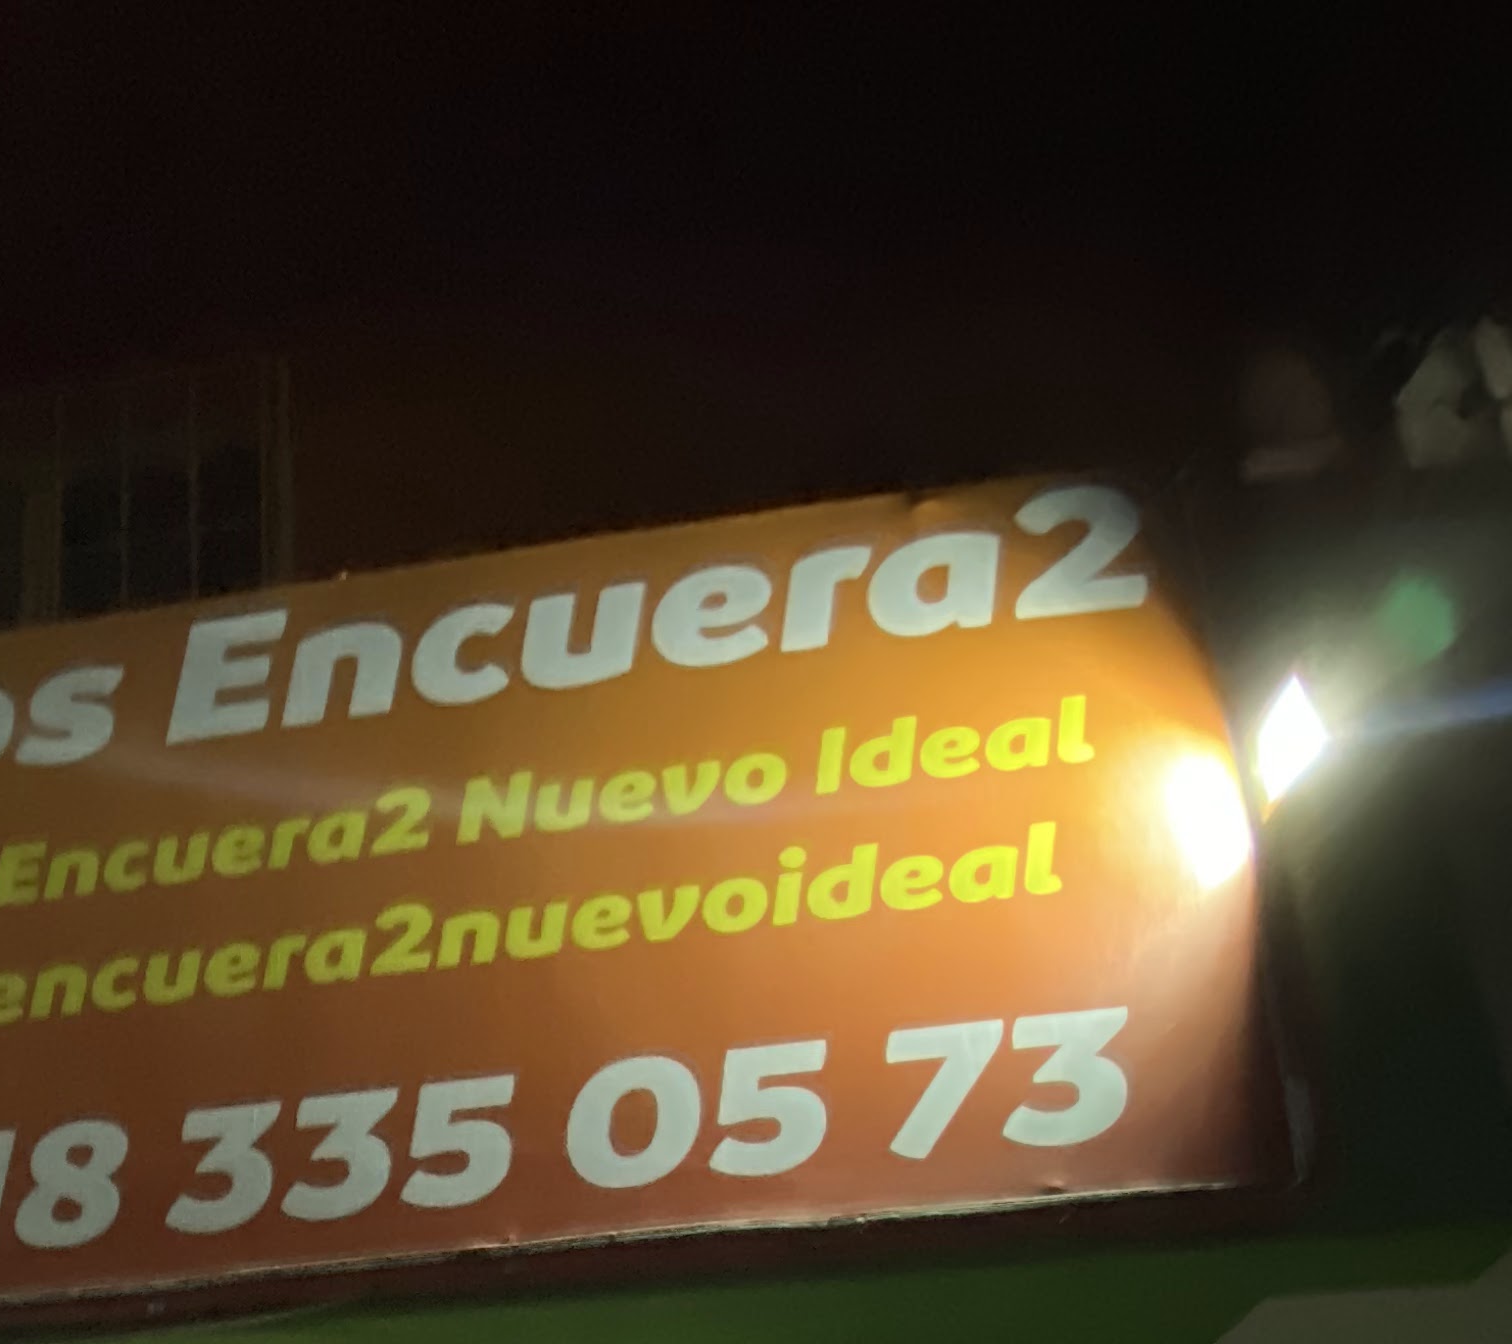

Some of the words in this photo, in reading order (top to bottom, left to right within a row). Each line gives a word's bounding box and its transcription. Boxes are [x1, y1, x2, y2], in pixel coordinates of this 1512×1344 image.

[166, 485, 1149, 745] Encuera2
[456, 752, 787, 844] Nuevo
[816, 694, 1095, 795] Ideal
[165, 1074, 516, 1234] 335
[566, 1039, 828, 1189] 05
[886, 1005, 1129, 1160] 73
